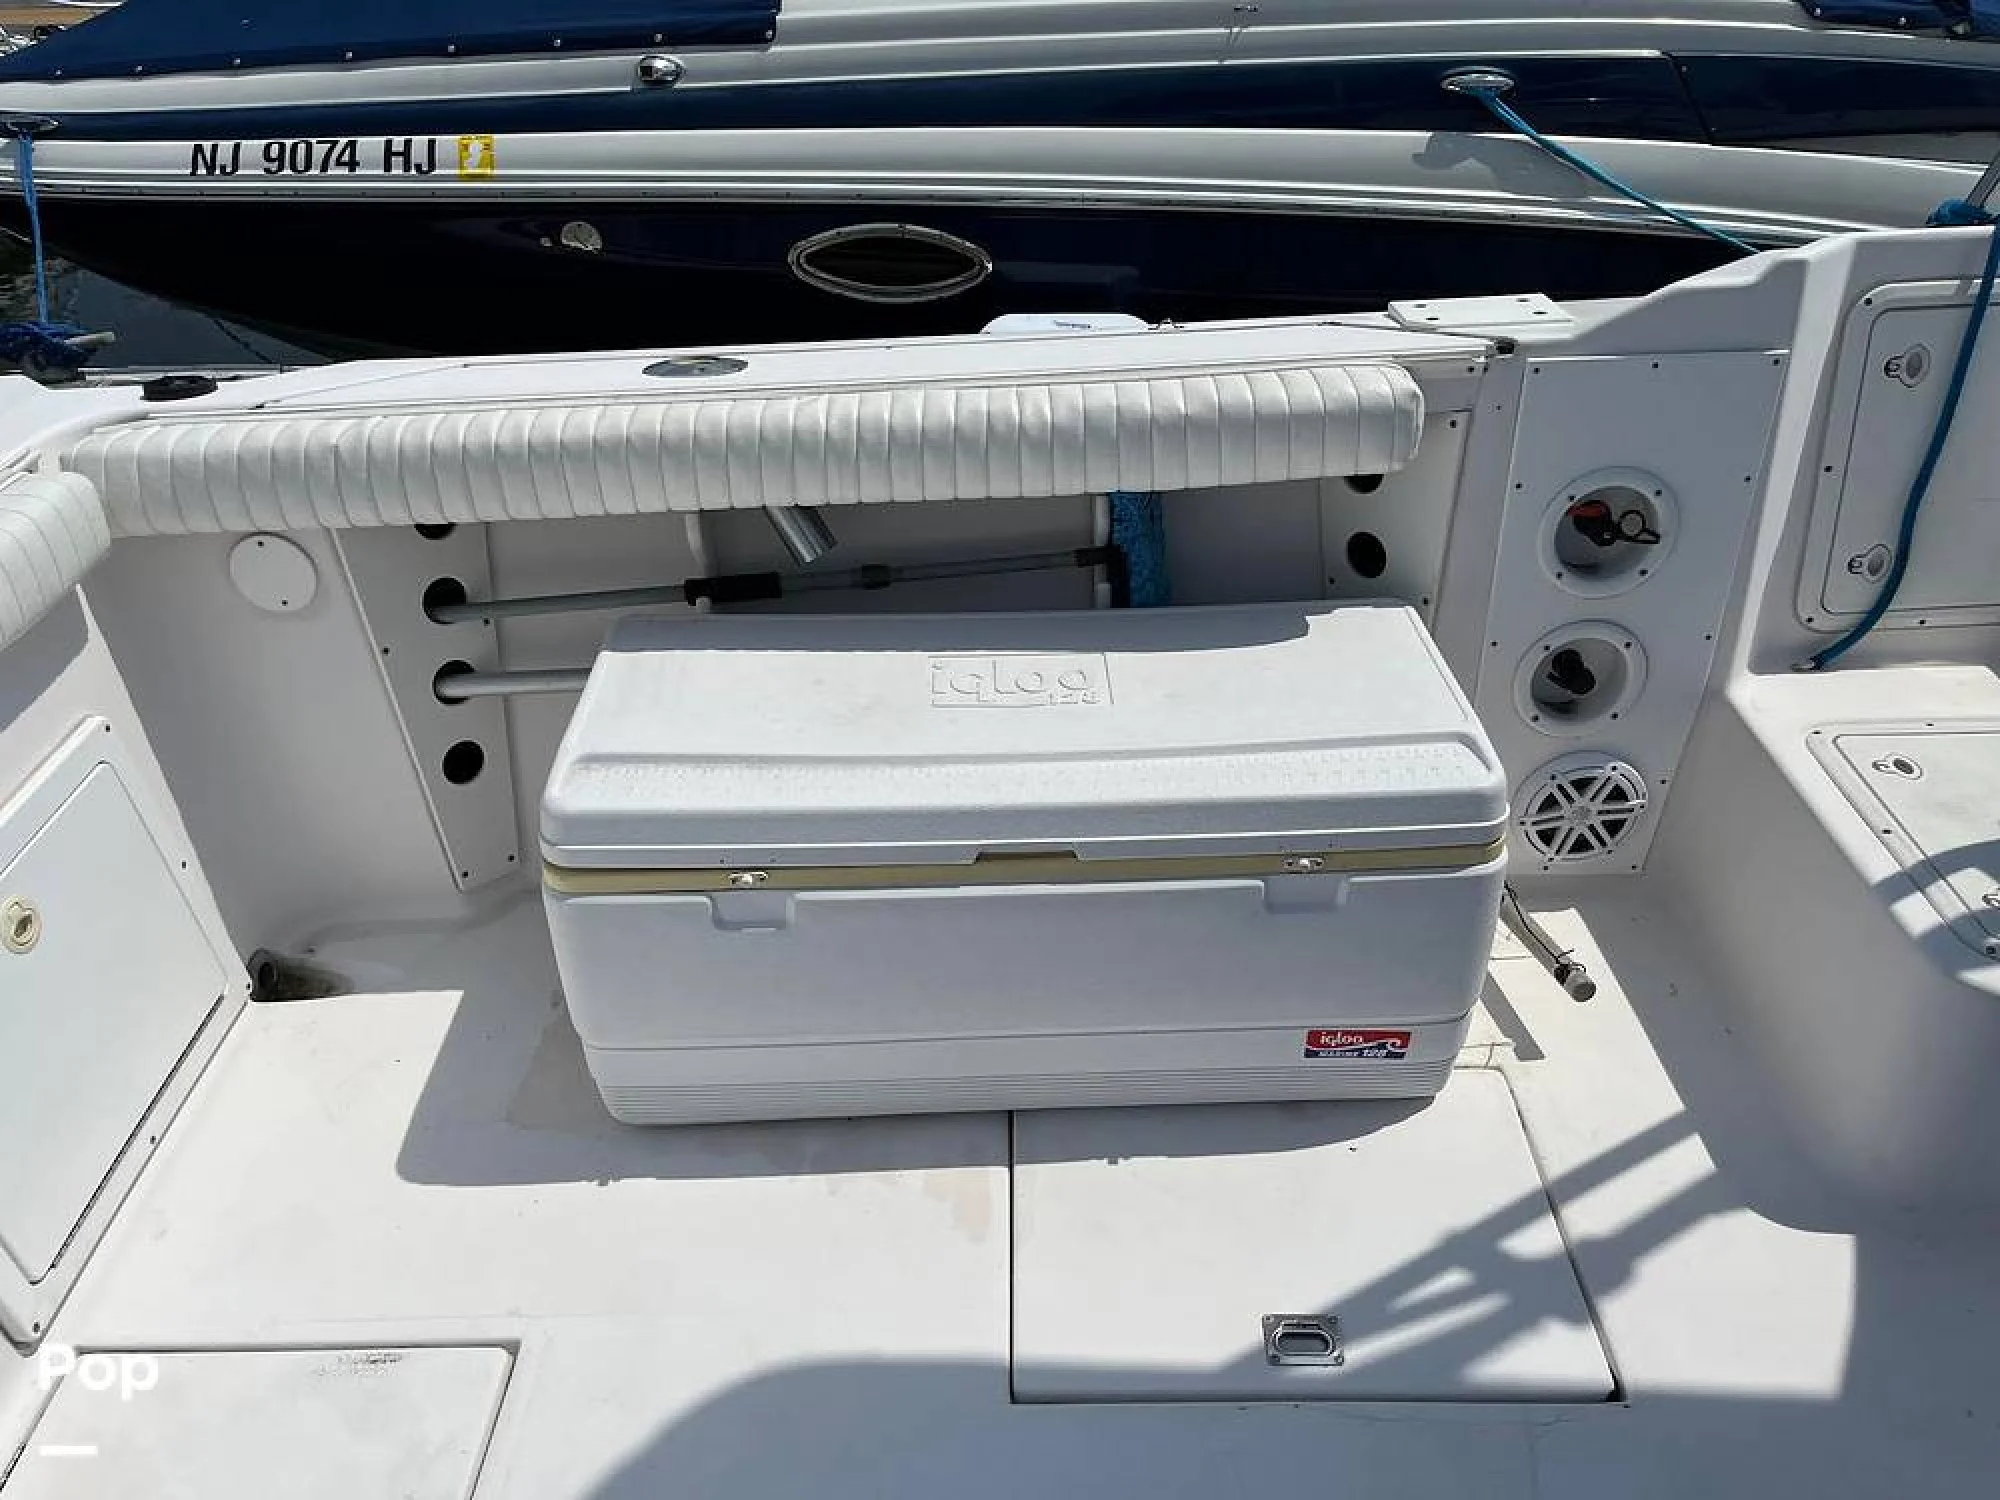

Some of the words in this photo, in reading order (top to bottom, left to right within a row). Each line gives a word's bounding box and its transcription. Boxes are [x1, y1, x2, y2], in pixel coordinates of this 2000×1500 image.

[189, 141, 240, 176] NJ
[262, 139, 360, 174] 9074
[383, 137, 437, 174] HJ
[931, 659, 1090, 702] igloo
[1320, 1031, 1364, 1047] igloo
